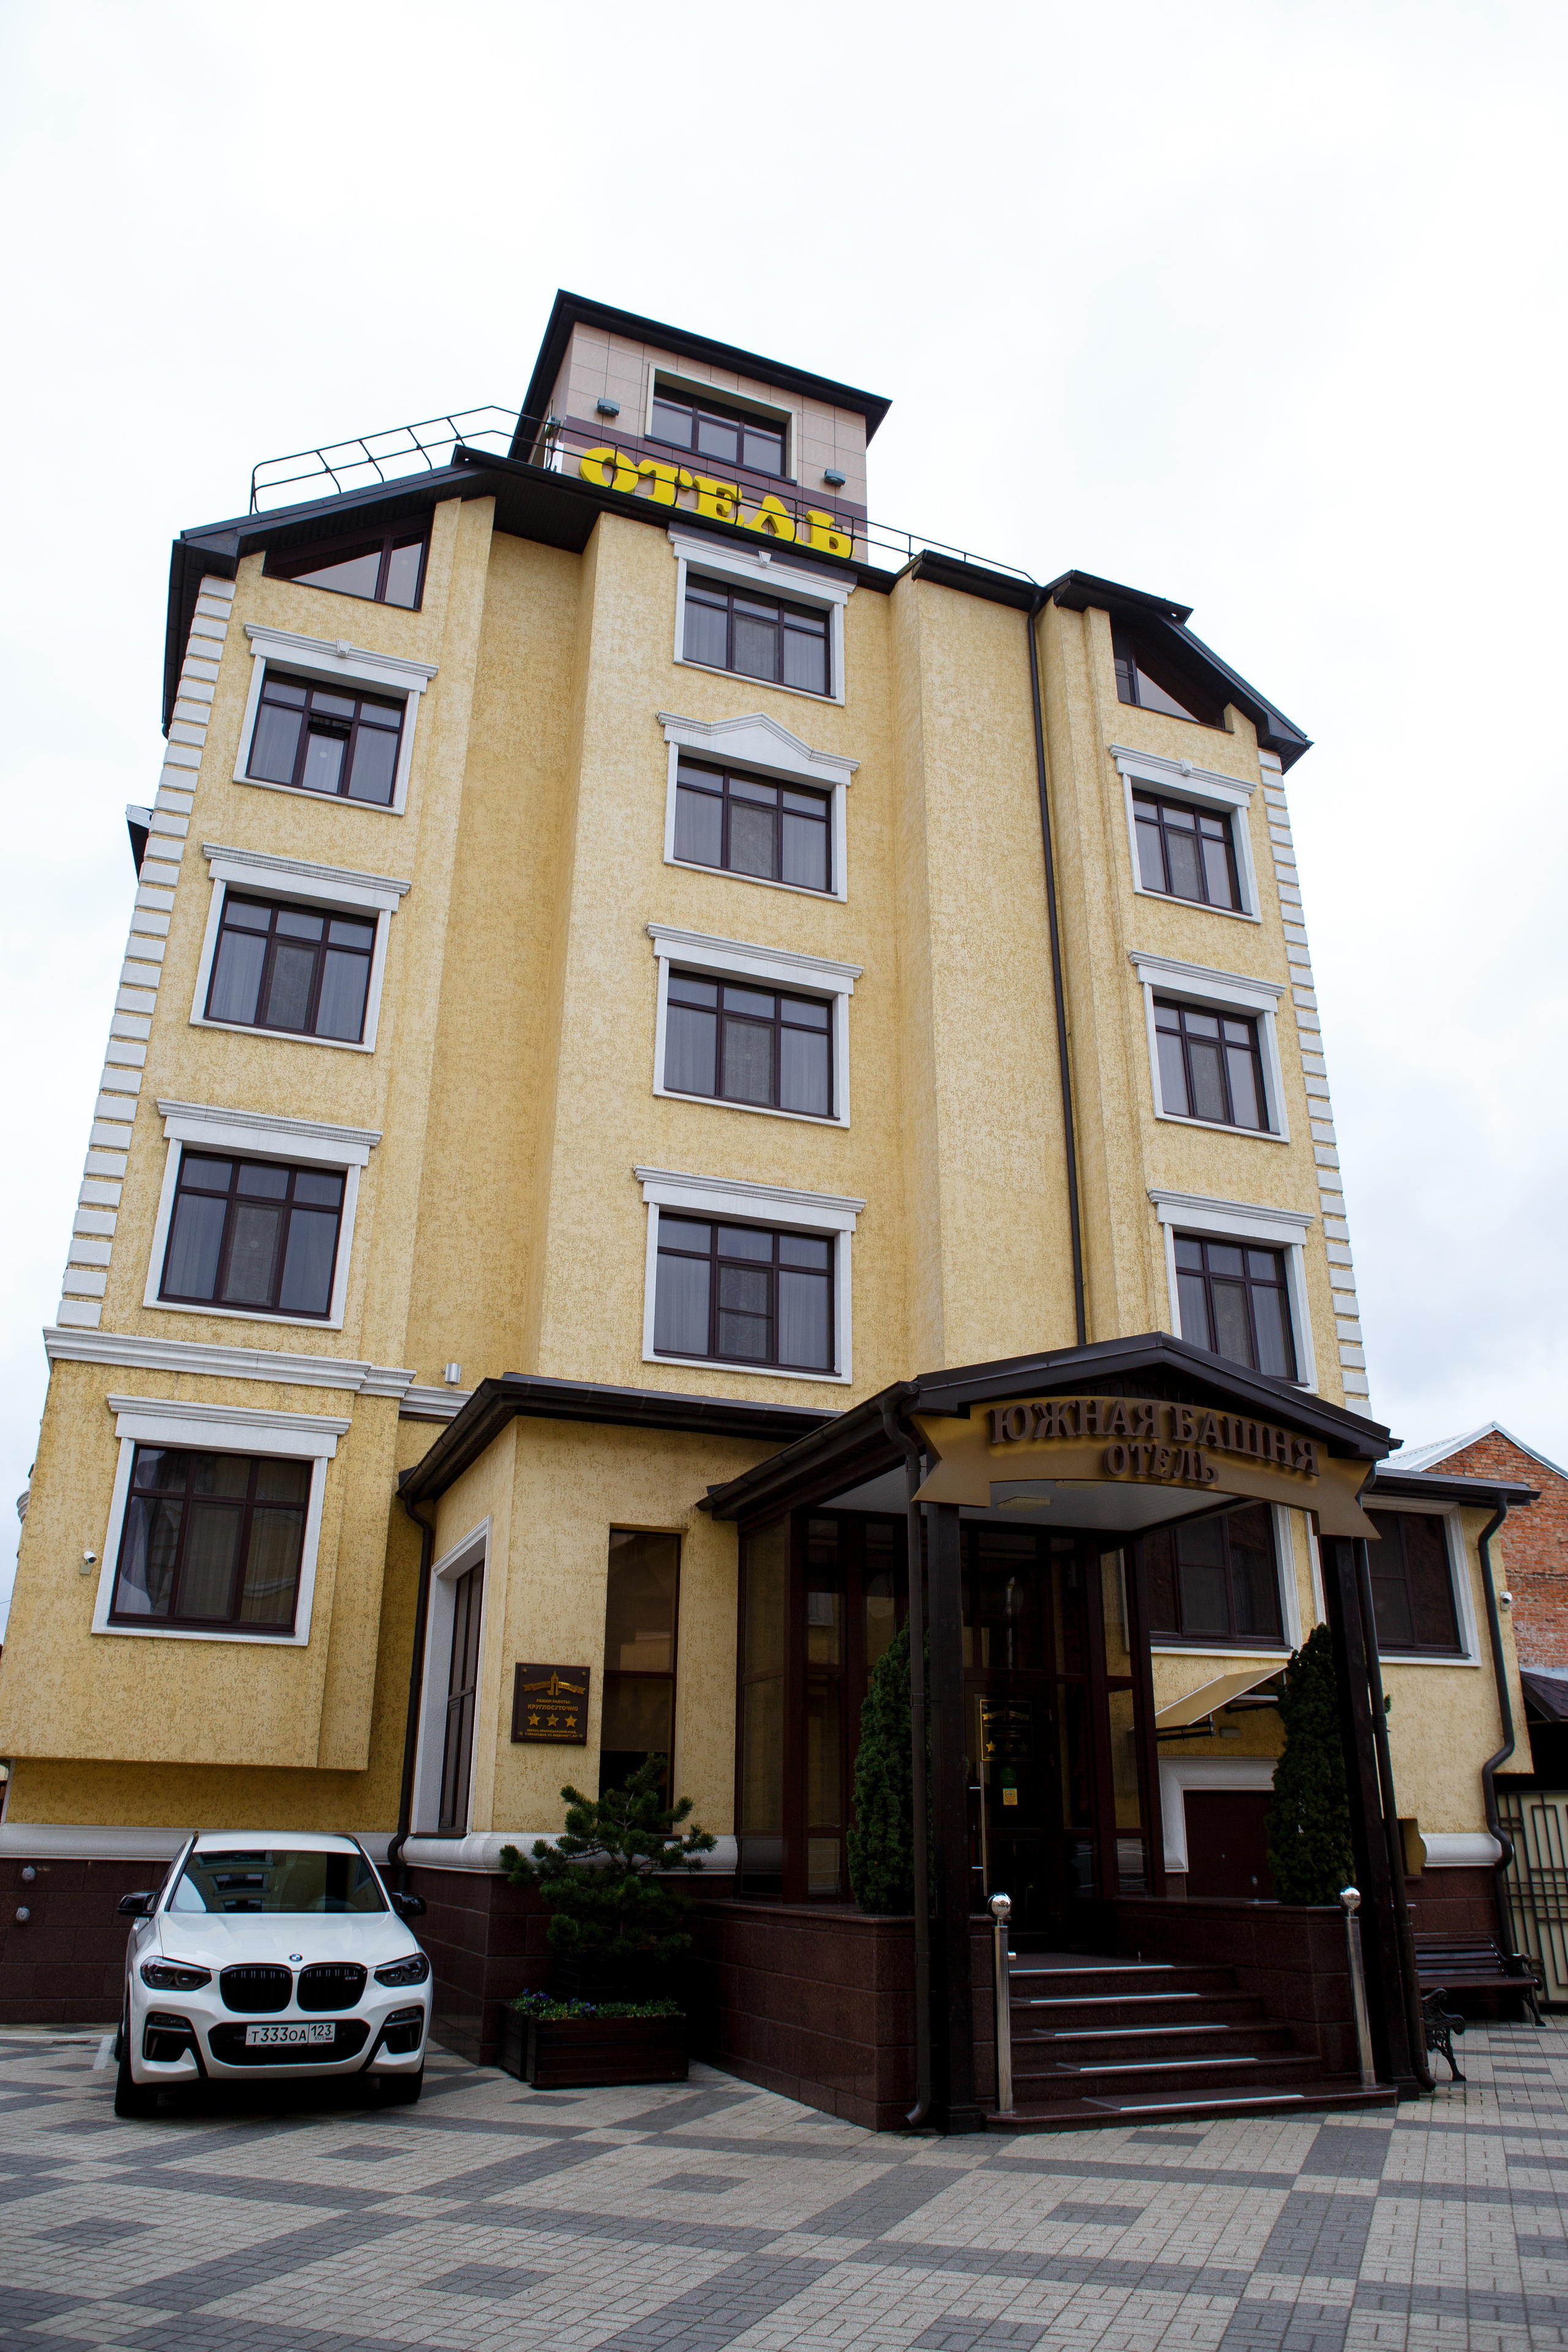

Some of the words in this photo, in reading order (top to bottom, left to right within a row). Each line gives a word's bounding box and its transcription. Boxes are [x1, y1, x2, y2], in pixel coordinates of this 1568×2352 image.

[579, 447, 854, 559] ОТЕЛЬ
[990, 1399, 1163, 1444] ЮЖНАЯ
[1170, 1405, 1321, 1477] БАШНЯ
[1104, 1442, 1219, 1484] ОТЕЛЬ
[252, 2027, 306, 2043] Т333ОА
[311, 2024, 331, 2037] 123
